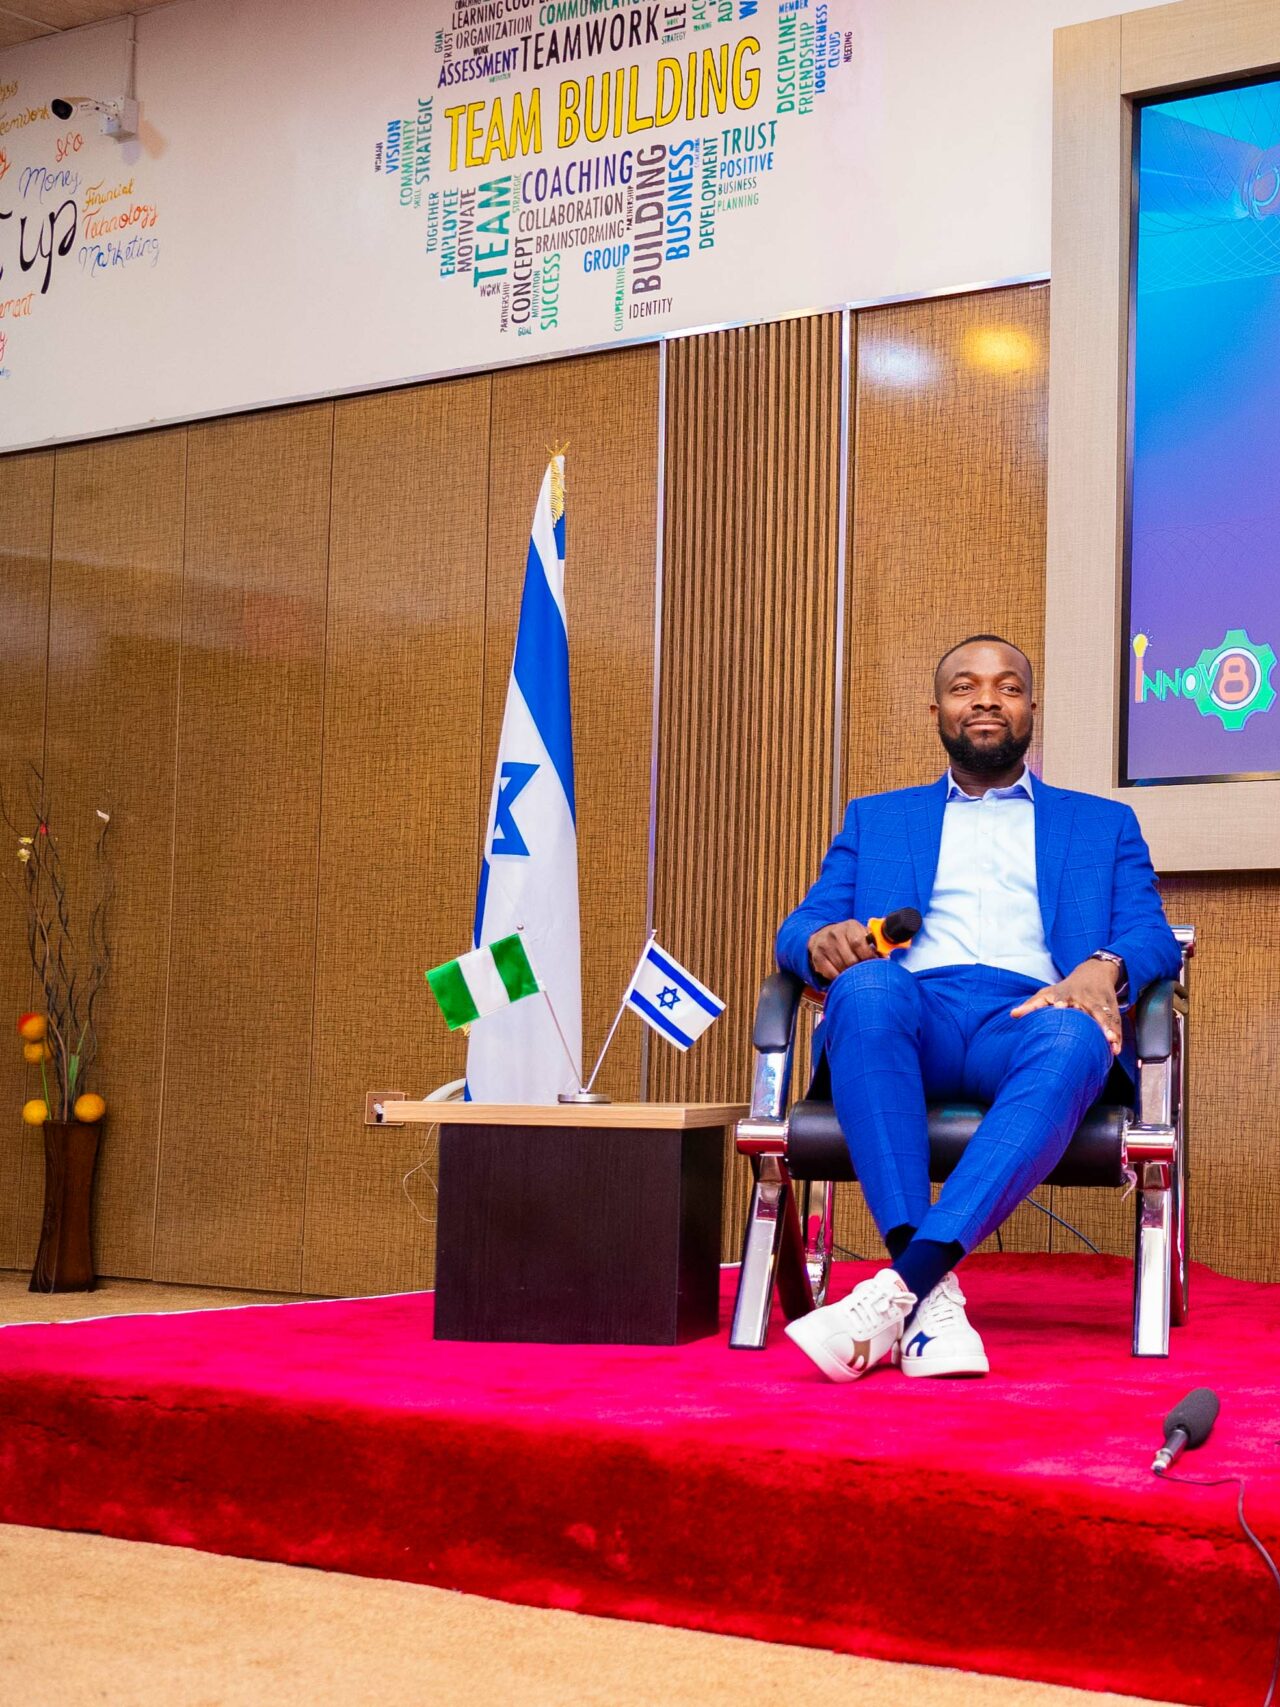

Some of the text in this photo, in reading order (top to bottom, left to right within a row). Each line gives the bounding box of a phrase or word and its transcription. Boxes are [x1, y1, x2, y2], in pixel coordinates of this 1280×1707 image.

[452, 1, 504, 30] LEARNING
[455, 14, 533, 50] ORGANIZATION
[520, 4, 660, 73] TEAMWORK
[437, 47, 519, 89] ASSESSMENT
[443, 32, 454, 64] TRUST
[776, 12, 797, 114] DISCIPLINE
[798, 22, 815, 116] FRIENDSHIP
[816, 4, 828, 95] TOGETHERNESS
[829, 31, 840, 68] CLOUD
[843, 31, 854, 63] MEETING
[443, 35, 763, 172] TEAM BUILDING
[386, 120, 401, 174] VISION
[399, 120, 416, 206] COMMUNITY
[414, 95, 434, 185] STRATEGIC
[721, 120, 778, 157] TRUST
[521, 150, 634, 206] COACHING
[717, 177, 757, 196] BUSINESS
[719, 152, 775, 180] POSITIVE
[512, 174, 522, 213] STRATEGIC
[518, 192, 624, 233] COLLABORATION
[626, 185, 635, 231] PARTNERSHIP
[665, 139, 696, 262] BUSINESS
[698, 137, 719, 250] DEVELOPMENT
[716, 193, 761, 213] PLANNING
[426, 191, 440, 254] TOGETHER
[439, 187, 459, 279] EMPLOYEE
[456, 187, 477, 273] MOTIVATE
[473, 175, 513, 288] TEAM
[535, 220, 625, 254] BRAINSTORMING
[631, 144, 668, 296] BUILDING
[511, 236, 534, 324] CONCEPT
[583, 243, 631, 273] GROUP
[480, 282, 501, 297] WORK
[500, 282, 510, 333] PARTNERSHIP
[532, 270, 540, 318] MOTIVATION
[540, 253, 561, 331] SUCCESS
[614, 267, 625, 331] COOPERATION
[629, 297, 673, 319] IDENTITY
